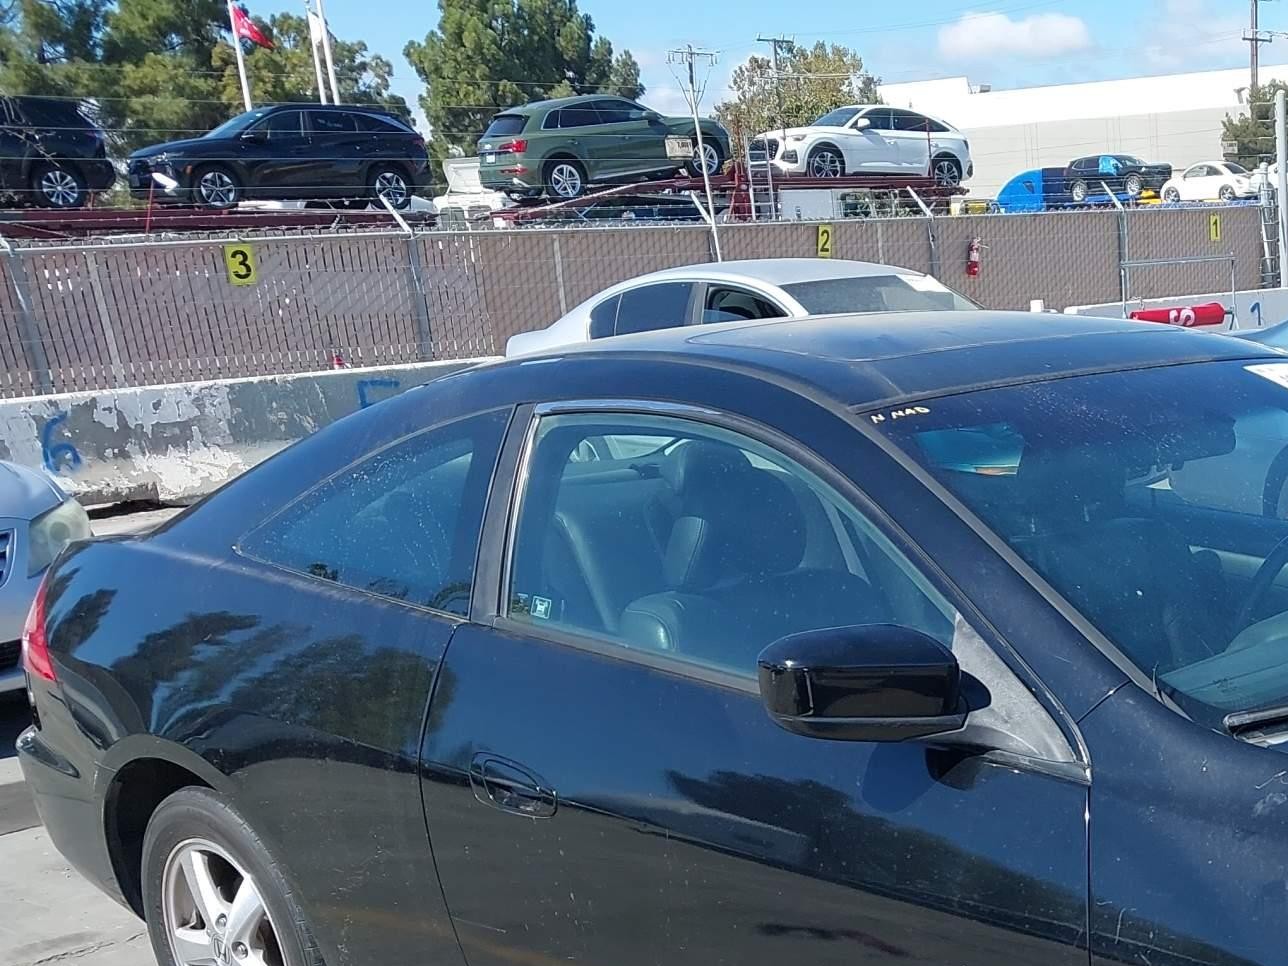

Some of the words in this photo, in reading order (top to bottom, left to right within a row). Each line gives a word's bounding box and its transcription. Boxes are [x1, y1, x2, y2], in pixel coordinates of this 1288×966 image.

[1212, 218, 1219, 238] 1
[819, 229, 830, 252] 2
[230, 249, 252, 280] 3
[1250, 302, 1262, 326] 1
[42, 410, 82, 474] 6
